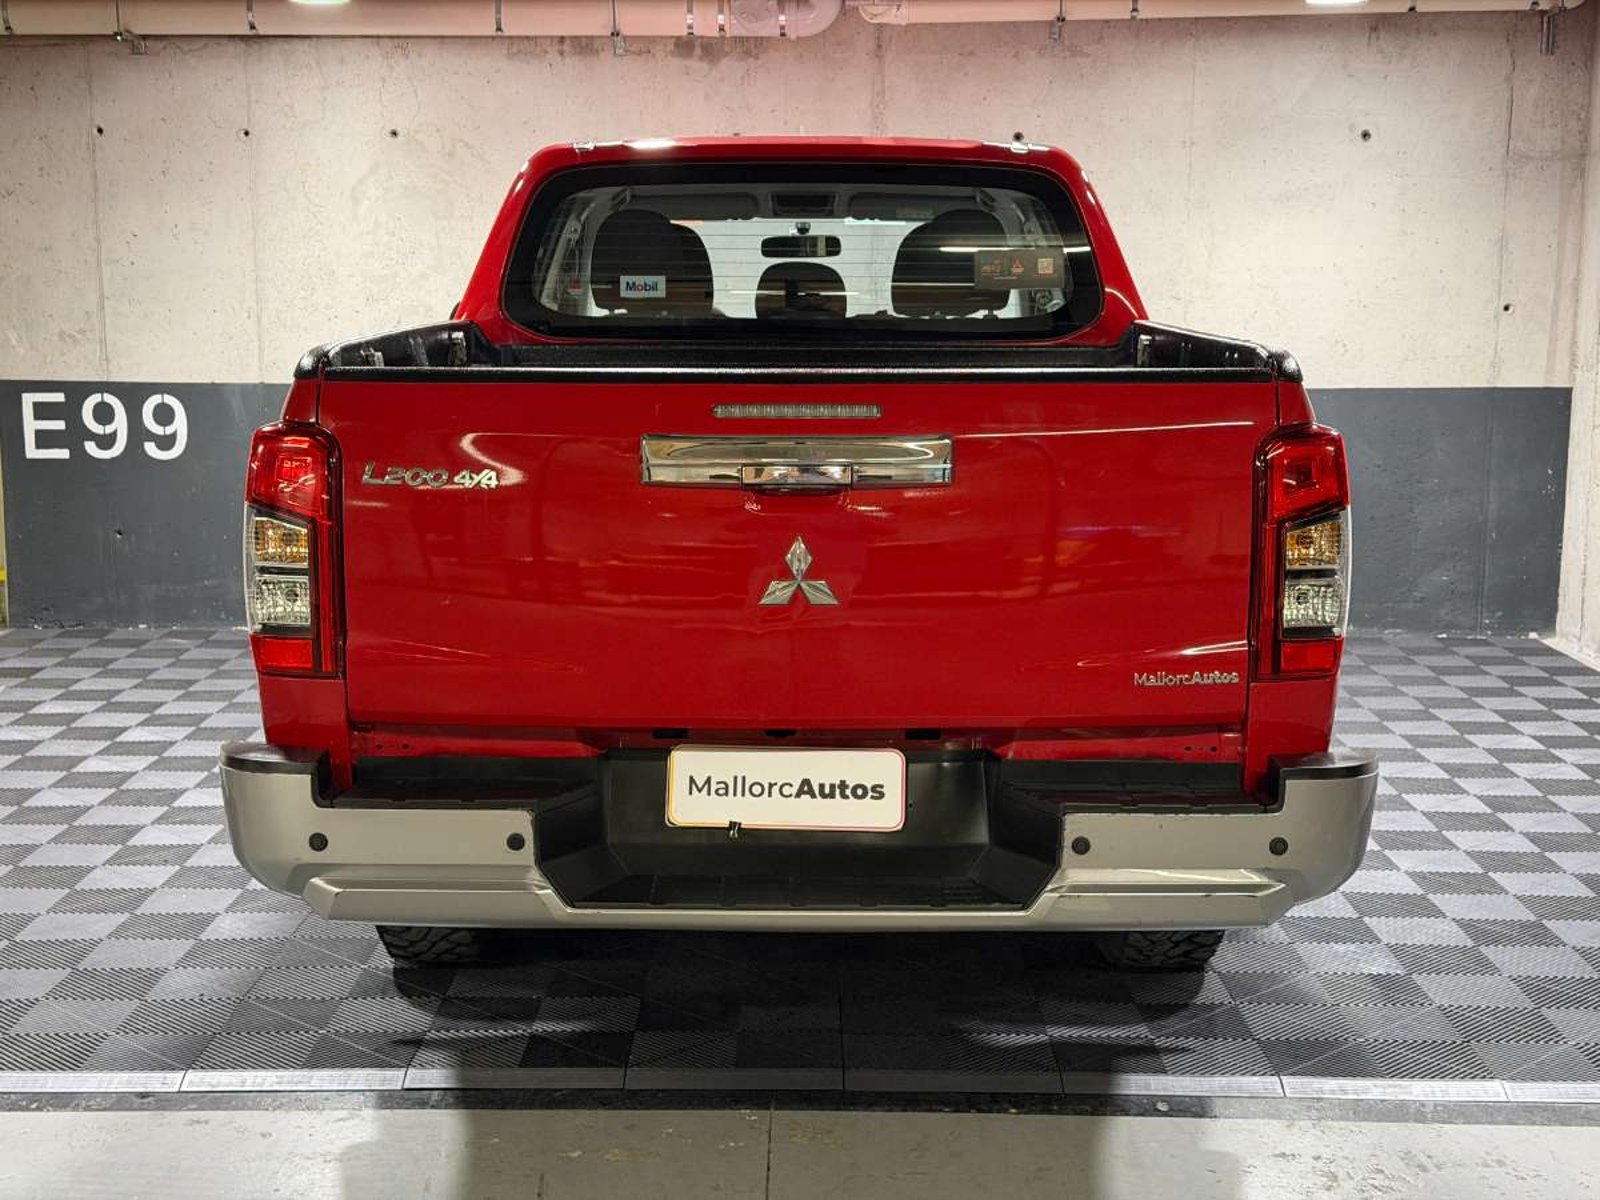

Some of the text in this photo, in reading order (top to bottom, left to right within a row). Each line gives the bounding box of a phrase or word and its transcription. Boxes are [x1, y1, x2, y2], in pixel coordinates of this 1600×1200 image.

[625, 280, 658, 292] Mobil
[21, 391, 188, 461] E99
[361, 461, 449, 488] L200
[1134, 670, 1240, 687] MallorcAutos
[687, 774, 886, 801] MallorcAutos
